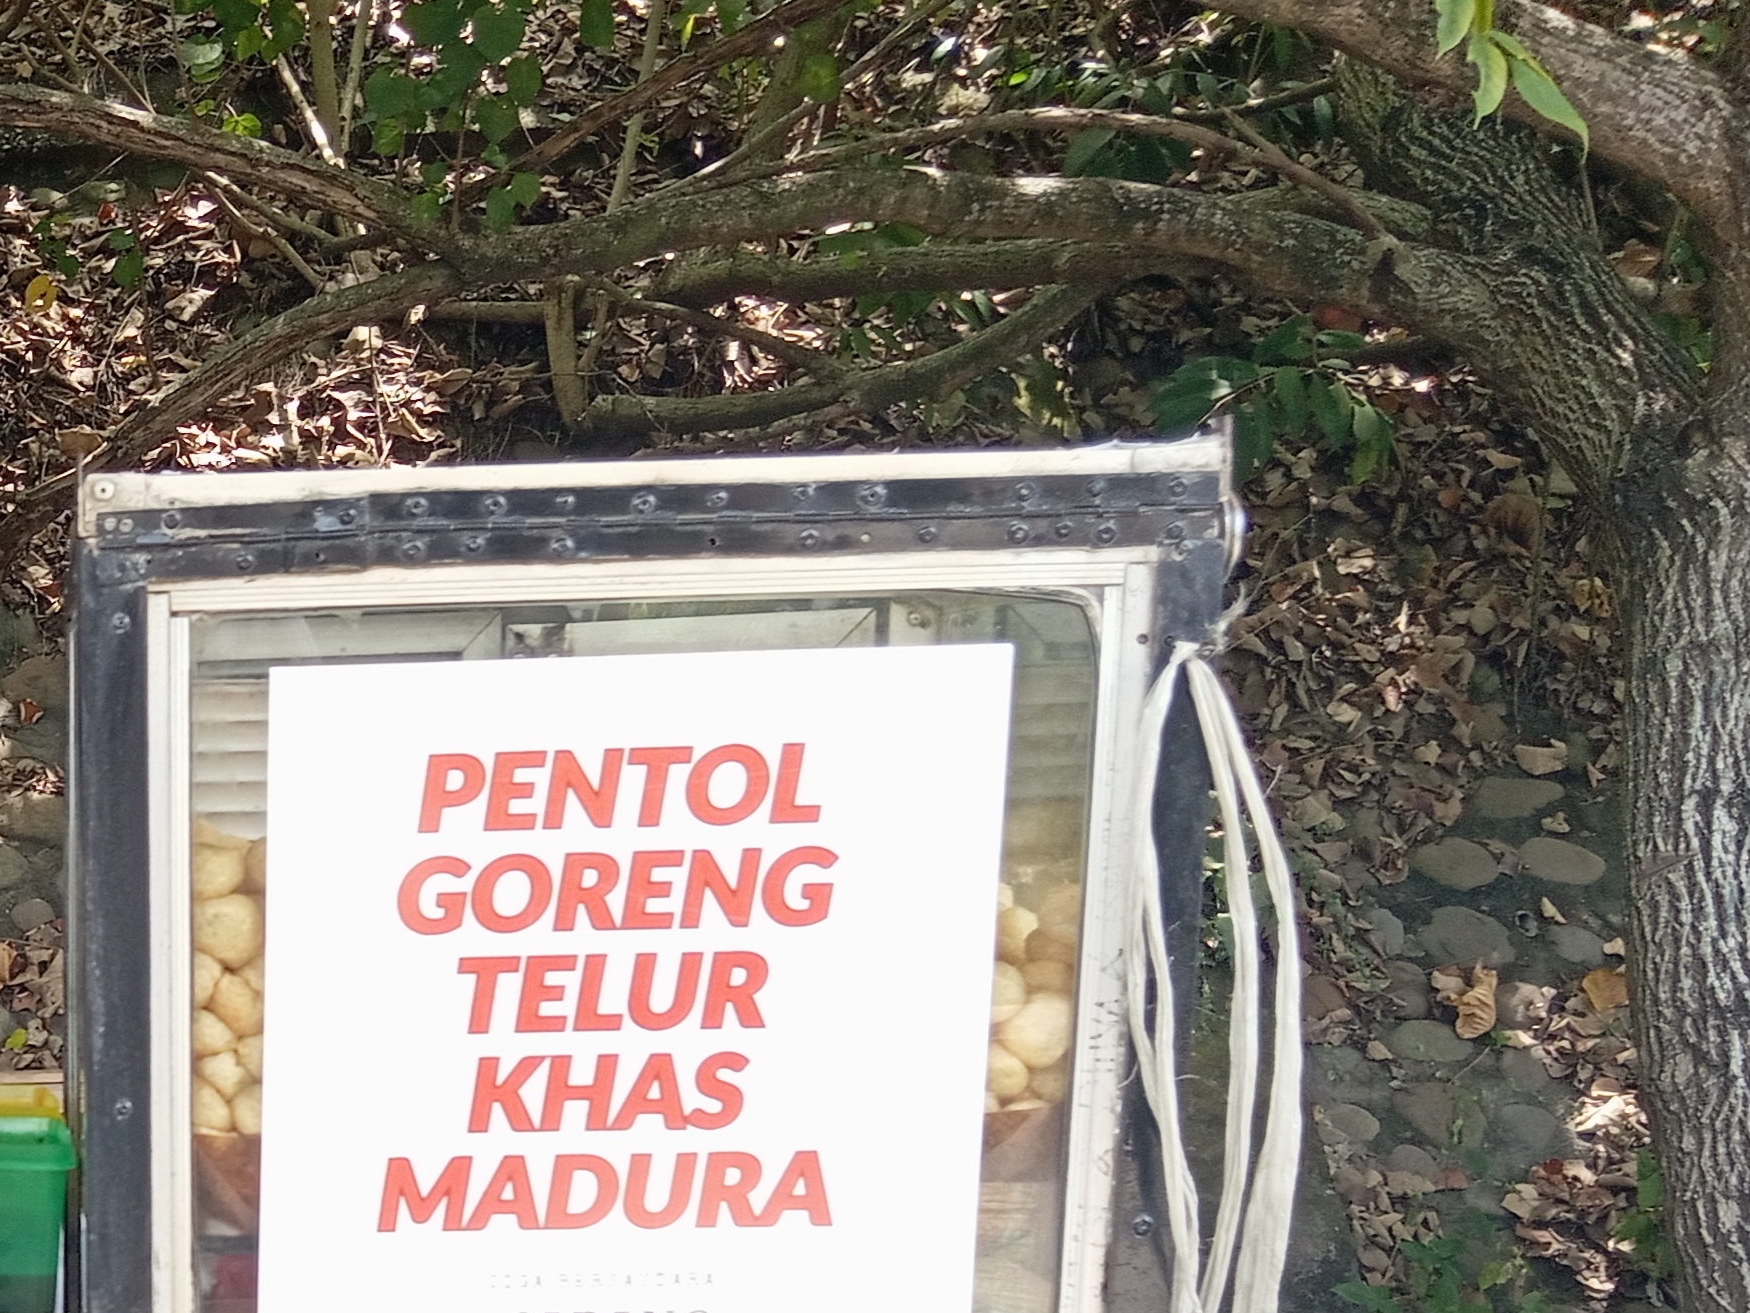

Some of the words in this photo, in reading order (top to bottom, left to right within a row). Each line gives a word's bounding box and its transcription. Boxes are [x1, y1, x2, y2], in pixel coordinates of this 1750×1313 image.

[417, 742, 821, 833] PENTOL
[396, 845, 839, 935] GORENG
[457, 950, 769, 1034] TELUR
[467, 1050, 750, 1133] KHAS
[377, 1150, 832, 1232] MADURA
